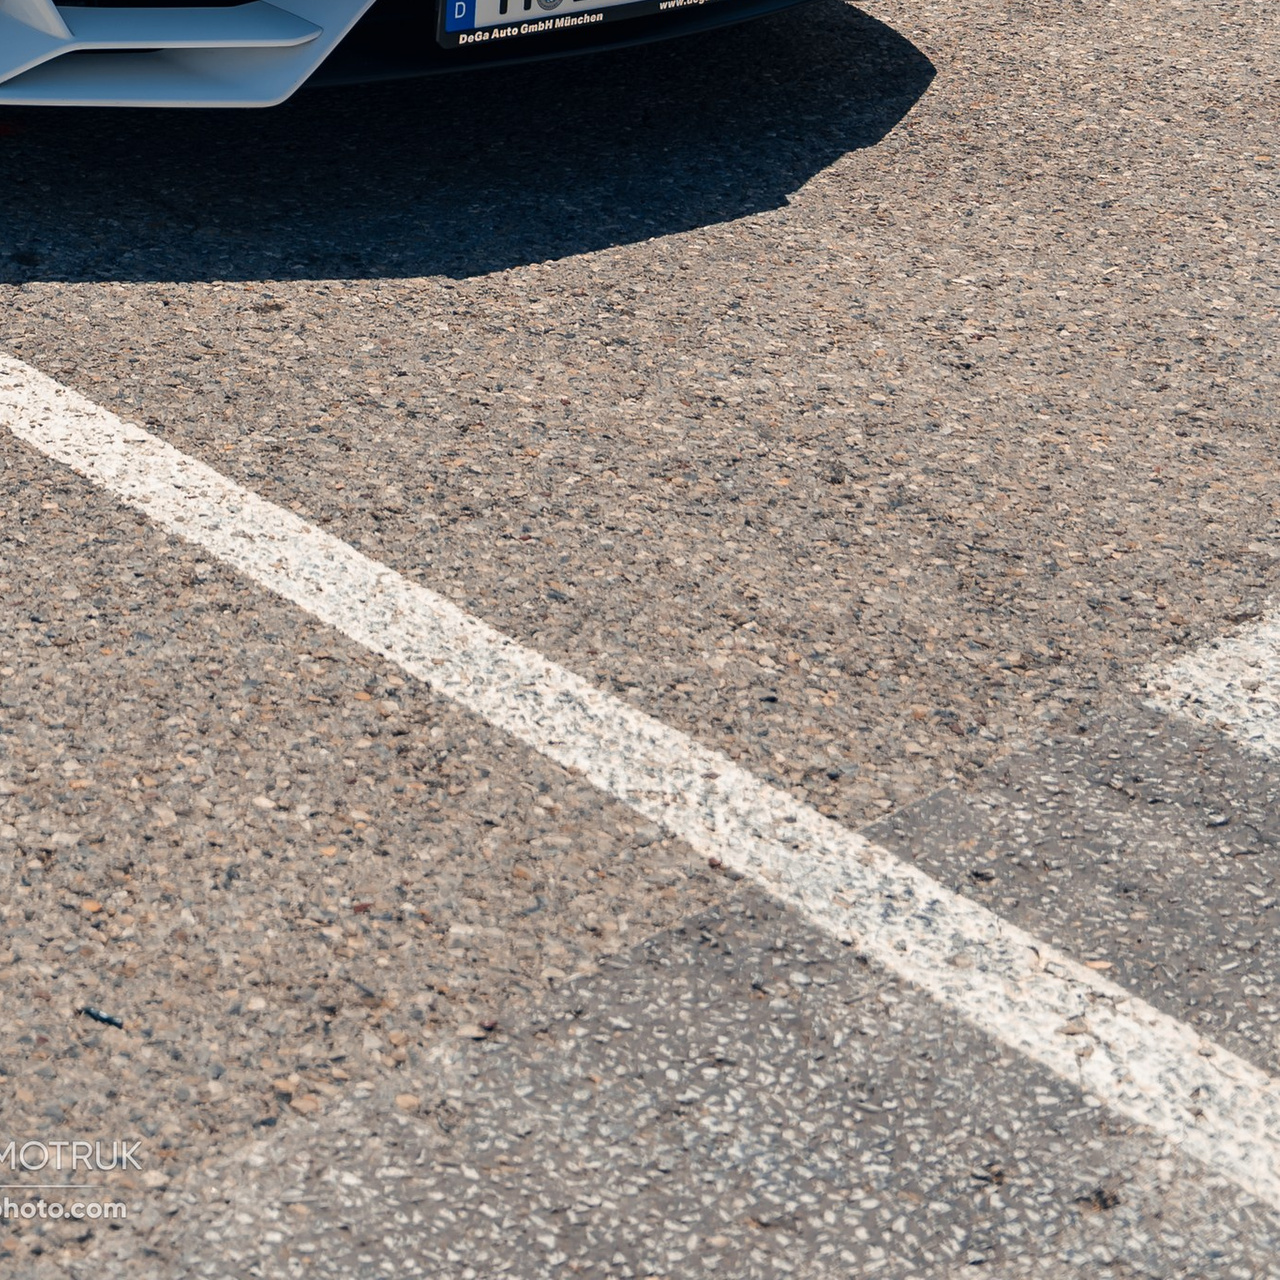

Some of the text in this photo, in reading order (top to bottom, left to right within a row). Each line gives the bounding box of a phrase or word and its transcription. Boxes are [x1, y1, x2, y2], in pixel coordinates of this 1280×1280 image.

[454, 1, 466, 20] D
[458, 11, 604, 45] DeGa Auto GmbH München
